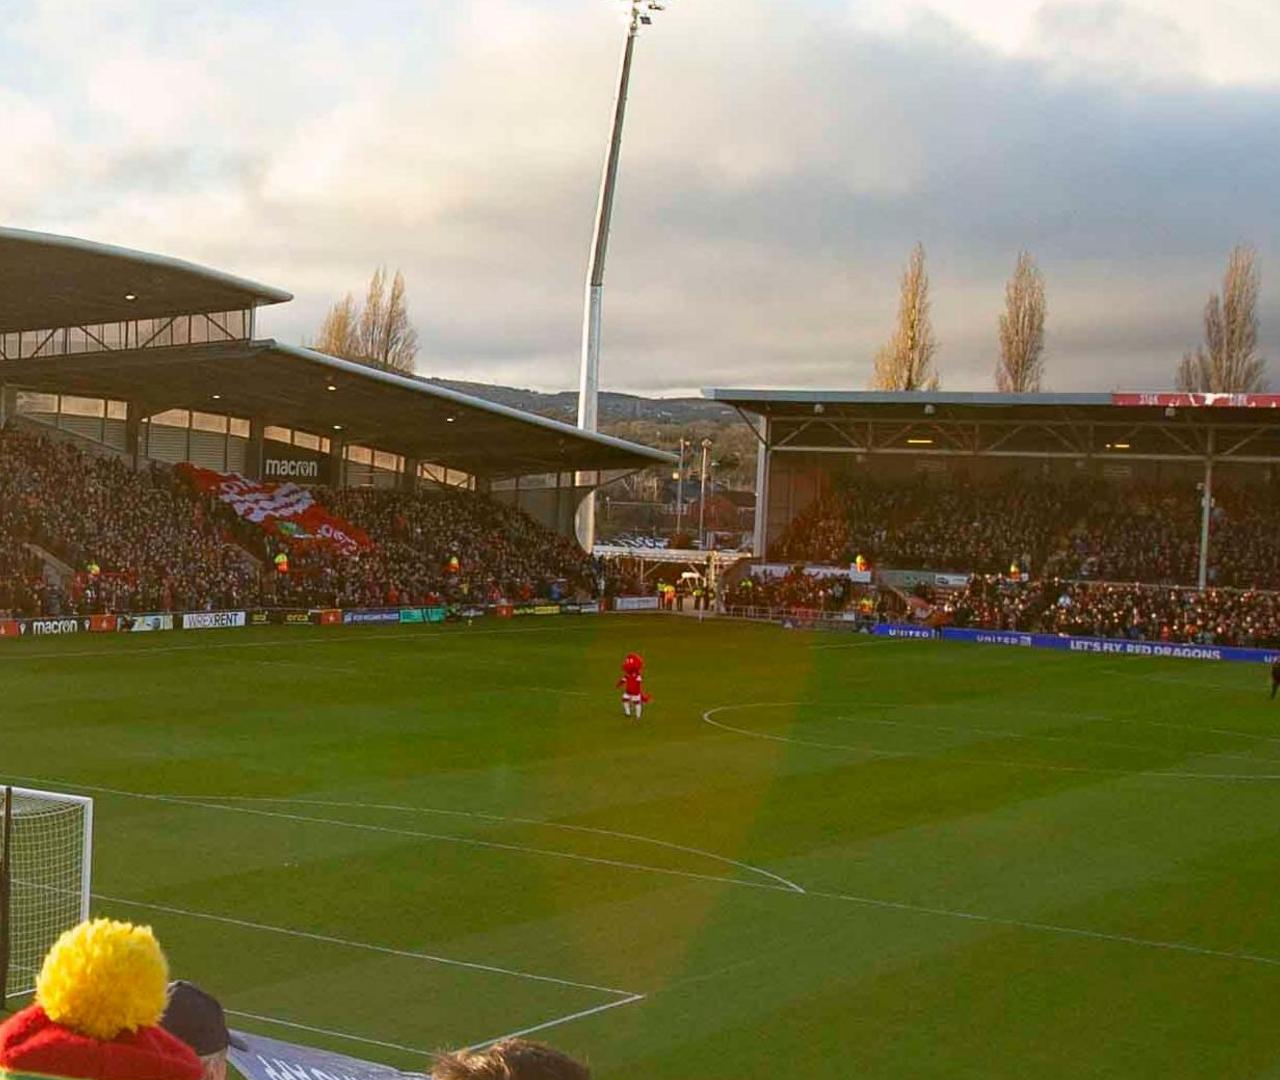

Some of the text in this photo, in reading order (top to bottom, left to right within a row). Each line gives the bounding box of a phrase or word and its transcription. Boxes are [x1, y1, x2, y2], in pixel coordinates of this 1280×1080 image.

[265, 459, 318, 477] macron
[33, 619, 78, 635] macron
[188, 613, 238, 628] WREXRENT
[976, 633, 1018, 645] UNITED
[1070, 639, 1101, 651] LET'S
[1126, 644, 1152, 655] RED
[1153, 646, 1221, 660] DRAGONS
